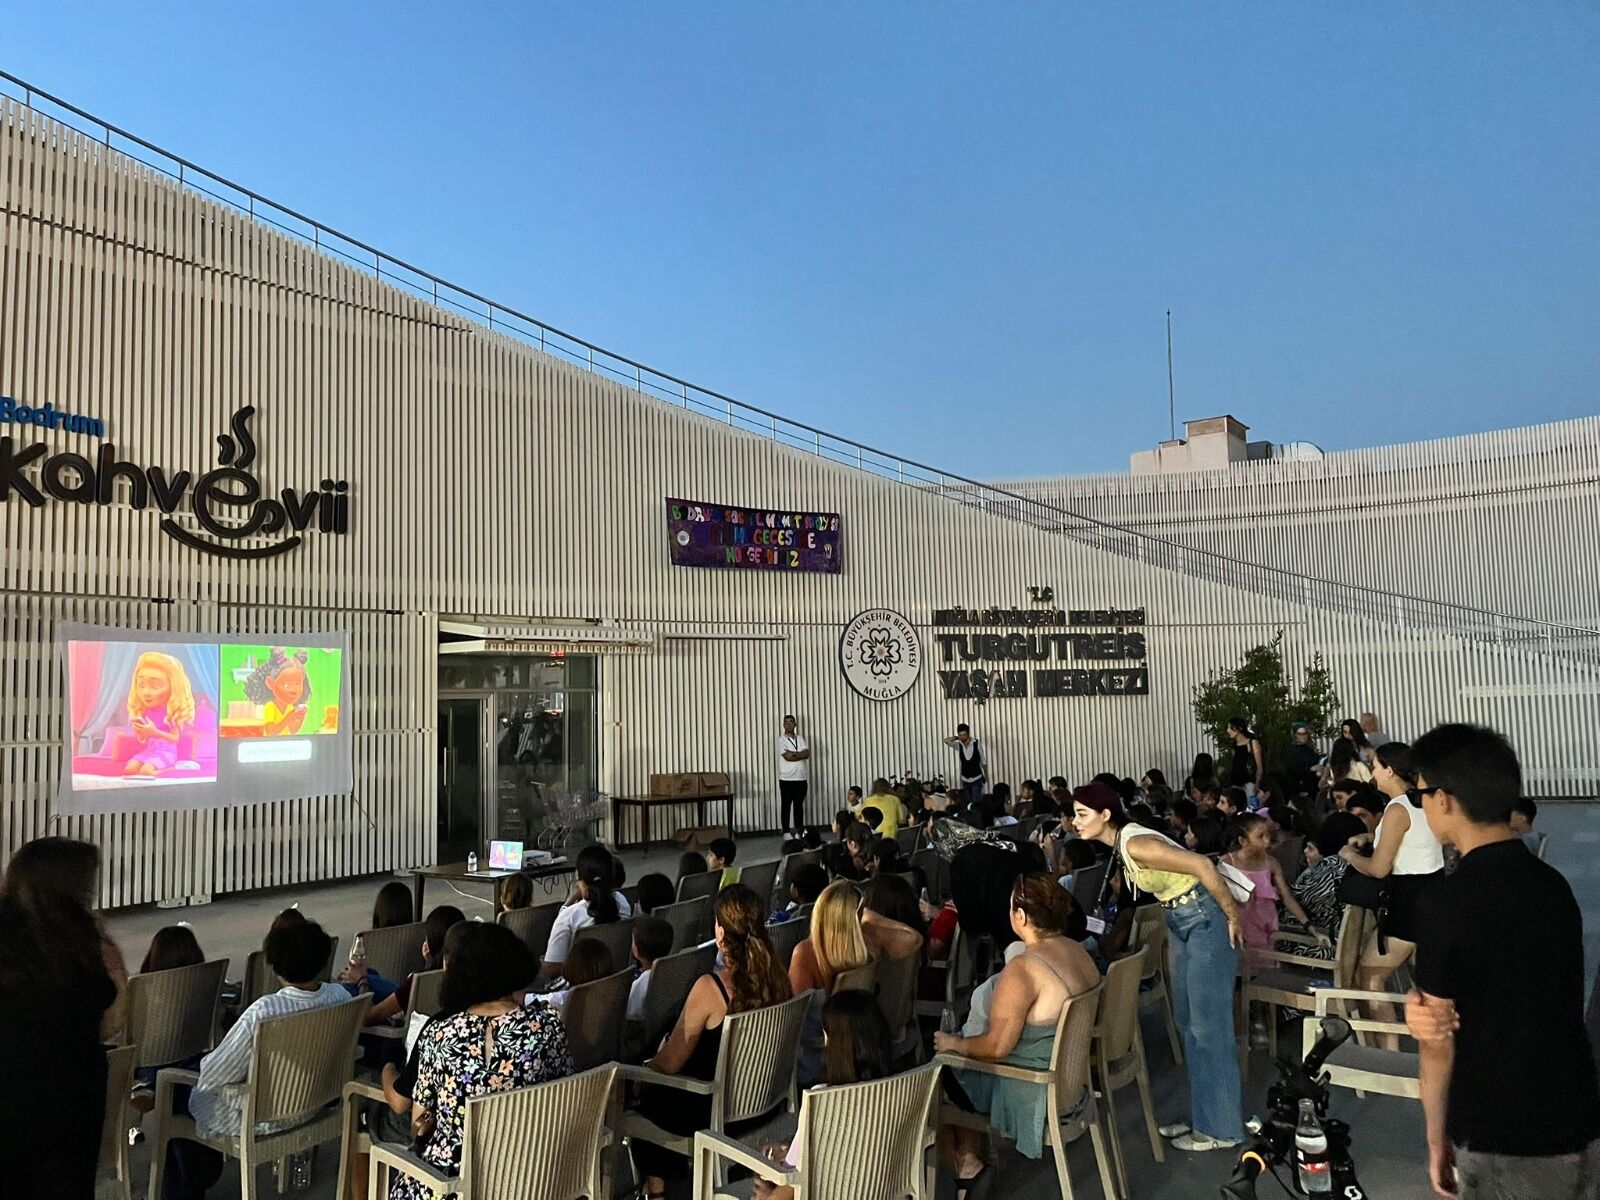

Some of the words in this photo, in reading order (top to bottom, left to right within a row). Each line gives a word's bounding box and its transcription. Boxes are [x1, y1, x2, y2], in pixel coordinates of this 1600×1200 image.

[0, 396, 104, 437] Bodrum
[753, 529, 816, 549] GECESE
[847, 612, 892, 647] BÜYÜKŞEHİR
[935, 627, 1146, 662] TURGUTREİS
[863, 685, 902, 698] MUĞLA
[937, 668, 1027, 704] YAŞAM
[1034, 662, 1149, 697] MERKEZİ
